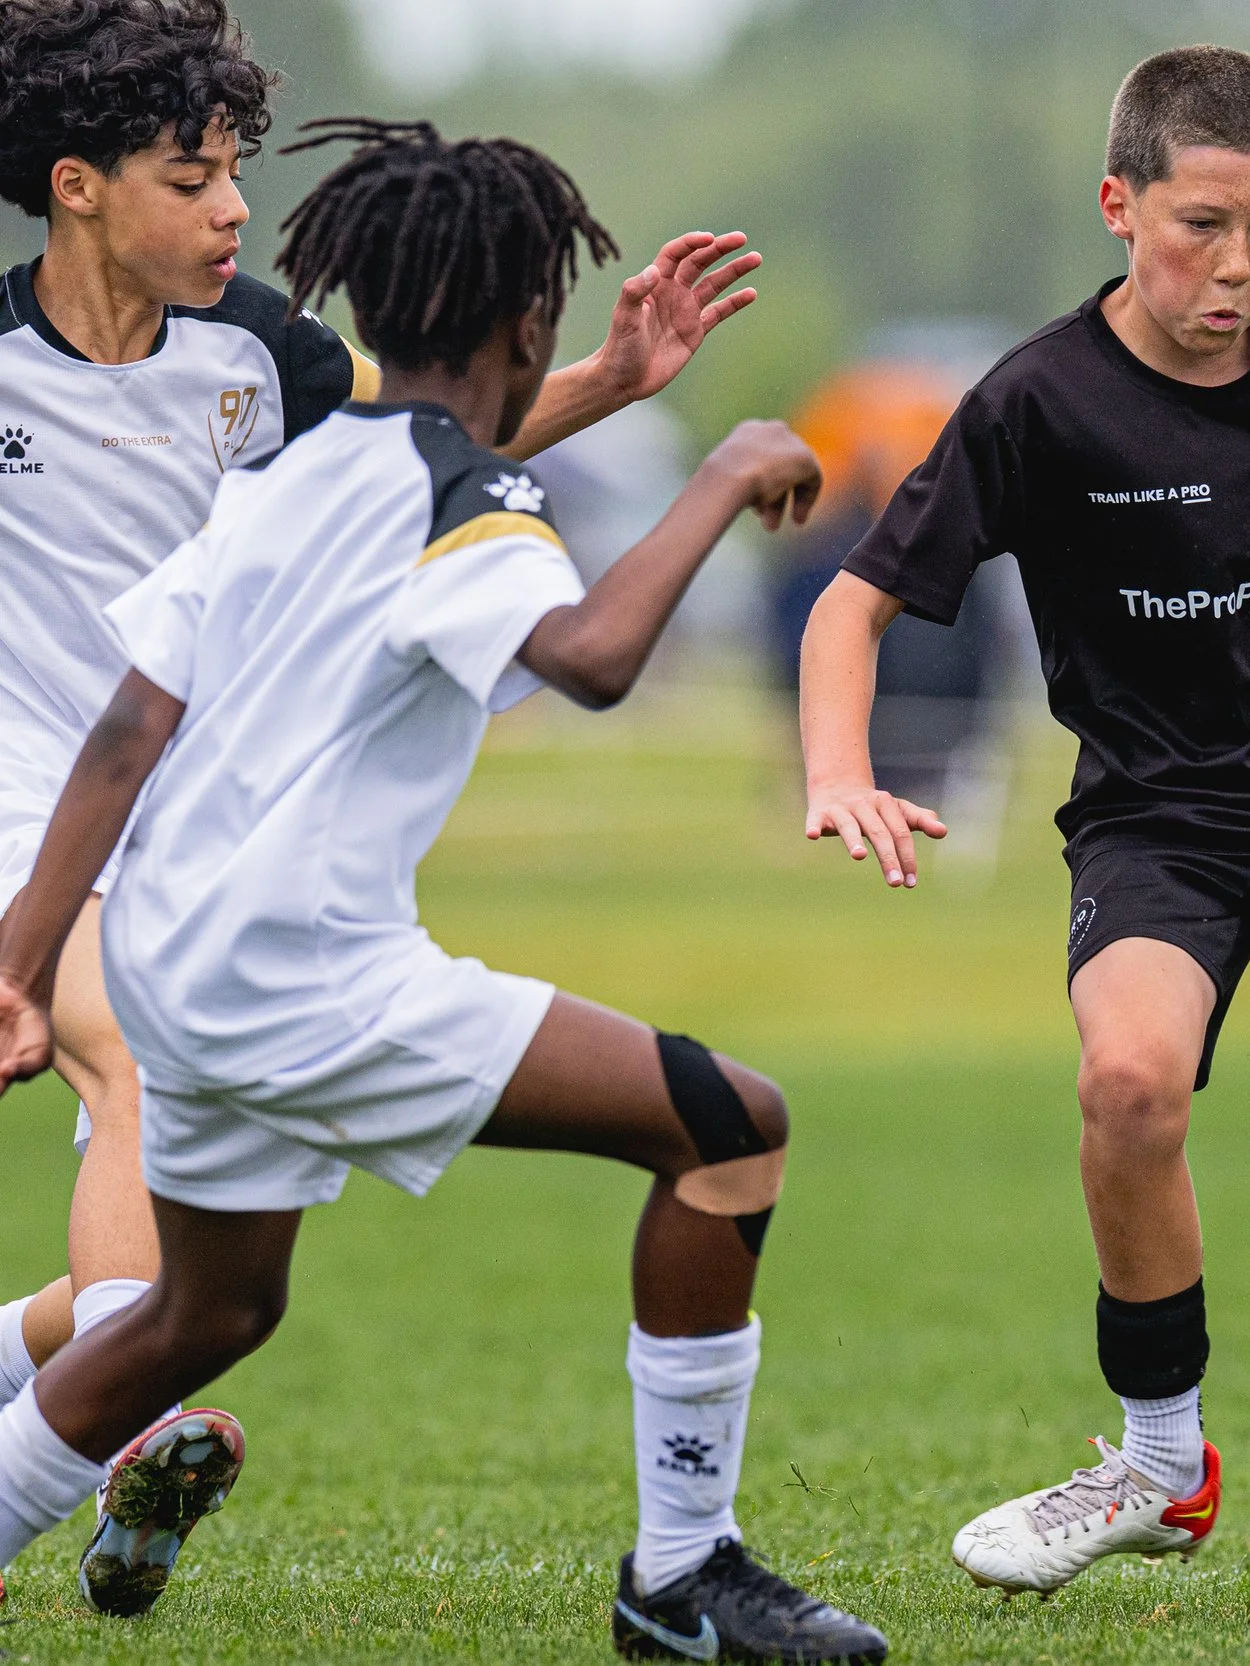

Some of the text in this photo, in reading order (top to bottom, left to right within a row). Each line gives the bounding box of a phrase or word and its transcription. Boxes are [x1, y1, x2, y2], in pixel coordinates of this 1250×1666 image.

[102, 435, 172, 447] DO THE EXTRA
[0, 462, 44, 473] ELME
[1088, 484, 1211, 503] TRAIN LIKE A PRO
